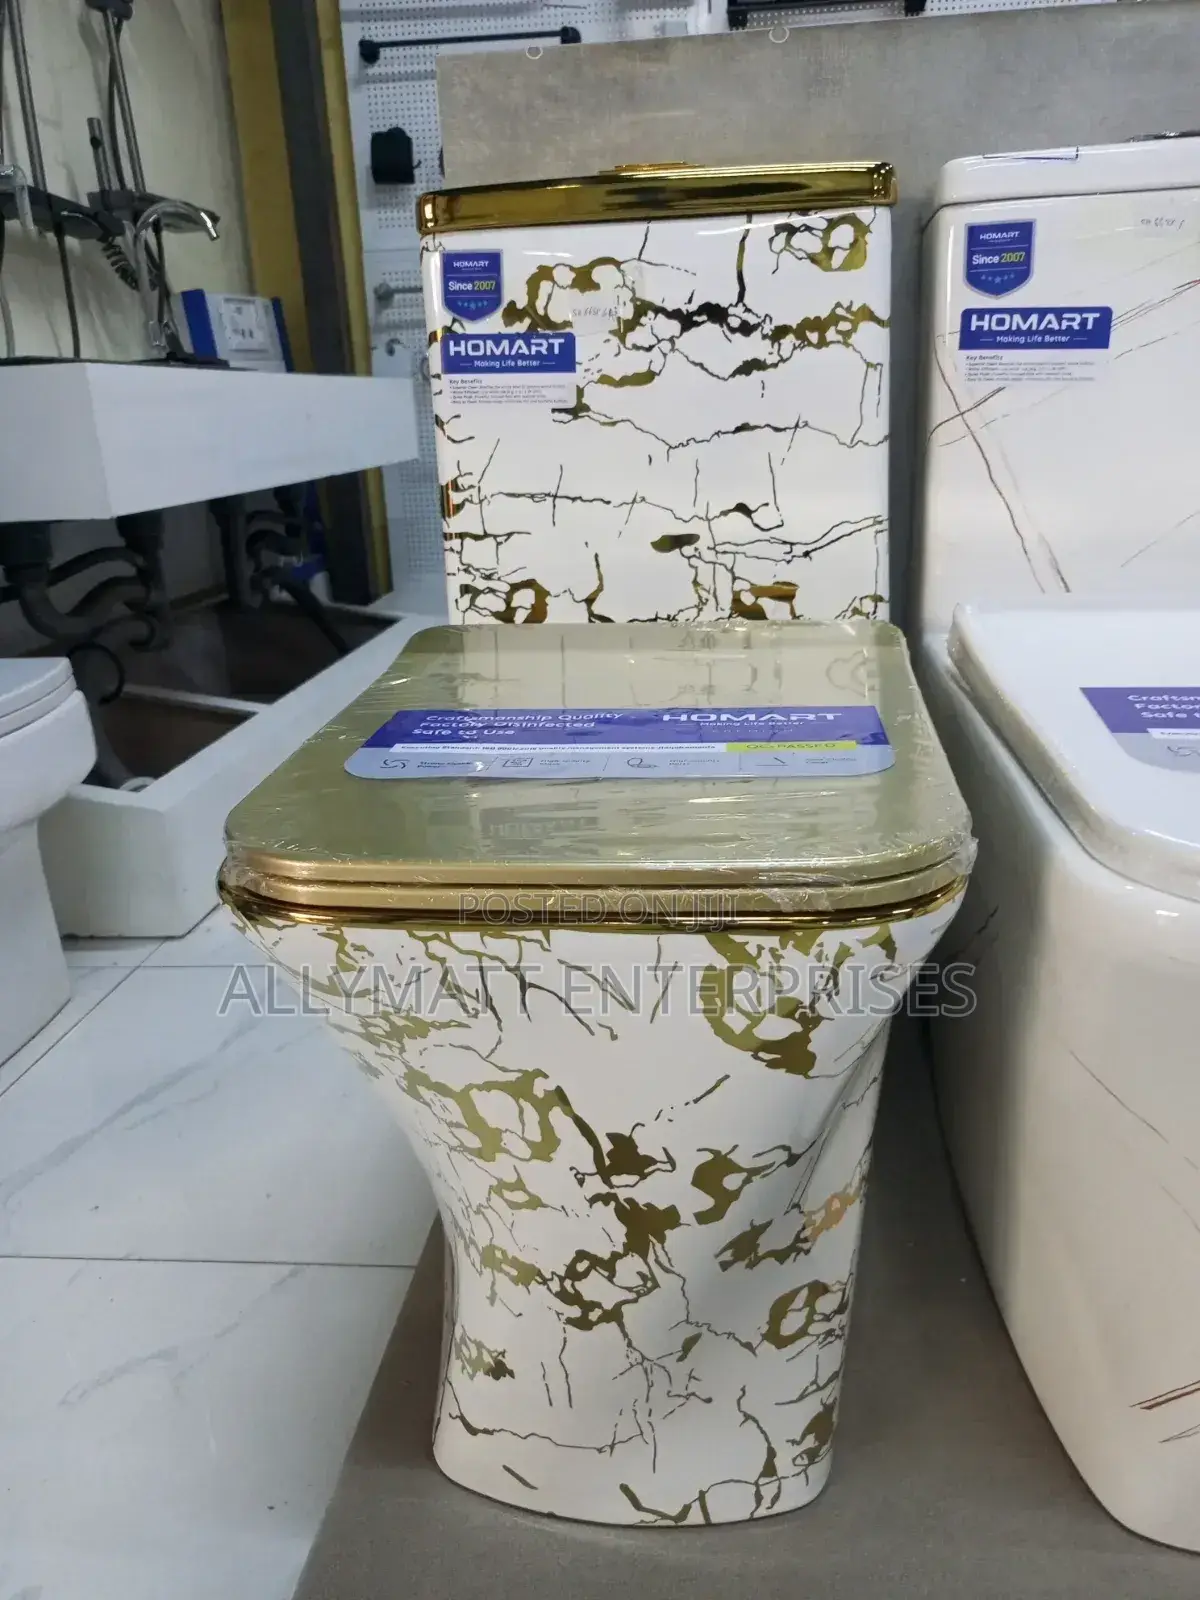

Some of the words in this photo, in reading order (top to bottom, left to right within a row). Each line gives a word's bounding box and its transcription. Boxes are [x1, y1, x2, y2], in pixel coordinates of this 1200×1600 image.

[979, 231, 1020, 240] HOMART
[972, 254, 999, 265] Since
[1001, 252, 1025, 263] 2007
[453, 260, 489, 268] HOMART
[448, 281, 473, 291] Since
[474, 281, 496, 291] 2007
[970, 313, 1100, 331] HOMART
[996, 335, 1025, 344] Making
[1027, 335, 1042, 343] Life
[1044, 335, 1070, 343] Better
[449, 339, 564, 357] HOMART
[474, 359, 500, 369] Making
[501, 359, 516, 368] Life
[517, 359, 540, 368] Better
[426, 713, 553, 722] Craftsmanship
[557, 711, 624, 721] Quality
[662, 713, 842, 722] HOMART
[419, 721, 484, 729] Factory
[493, 721, 596, 729] Disinfected
[412, 728, 452, 736] Safe
[483, 728, 516, 736] Use
